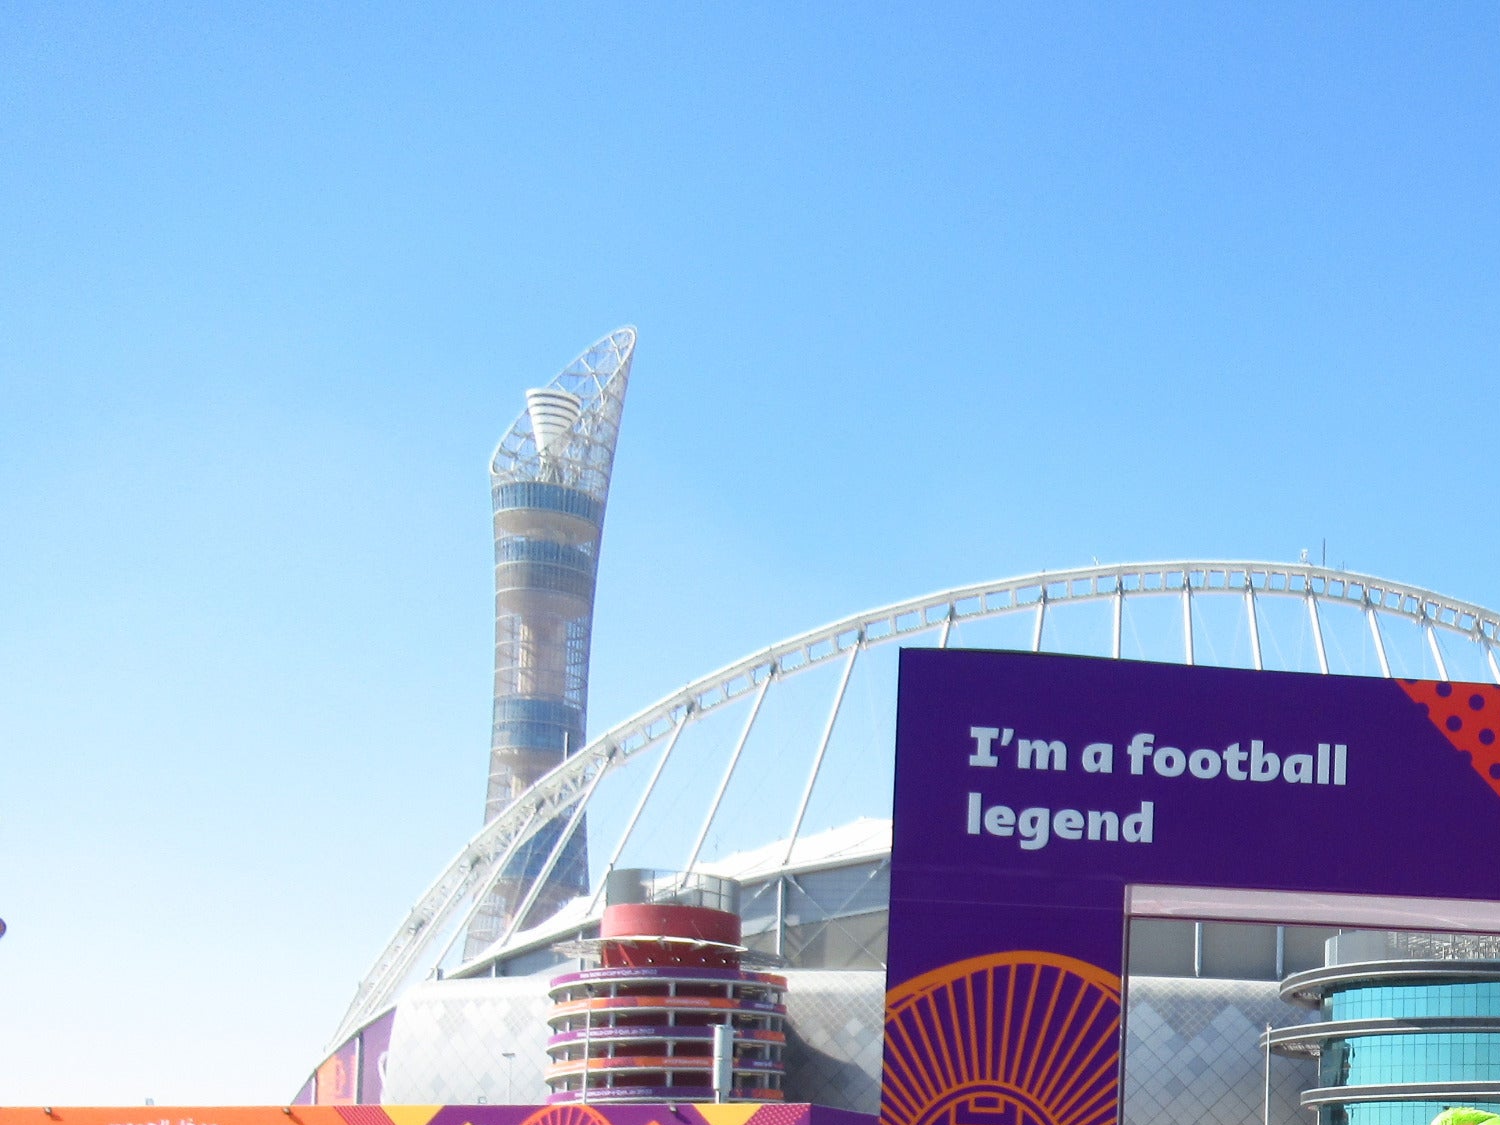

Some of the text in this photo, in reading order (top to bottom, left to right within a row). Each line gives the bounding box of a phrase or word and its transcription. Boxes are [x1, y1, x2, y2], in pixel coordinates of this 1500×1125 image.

[969, 727, 1348, 786] I'm a football
[967, 792, 1154, 851] legend
